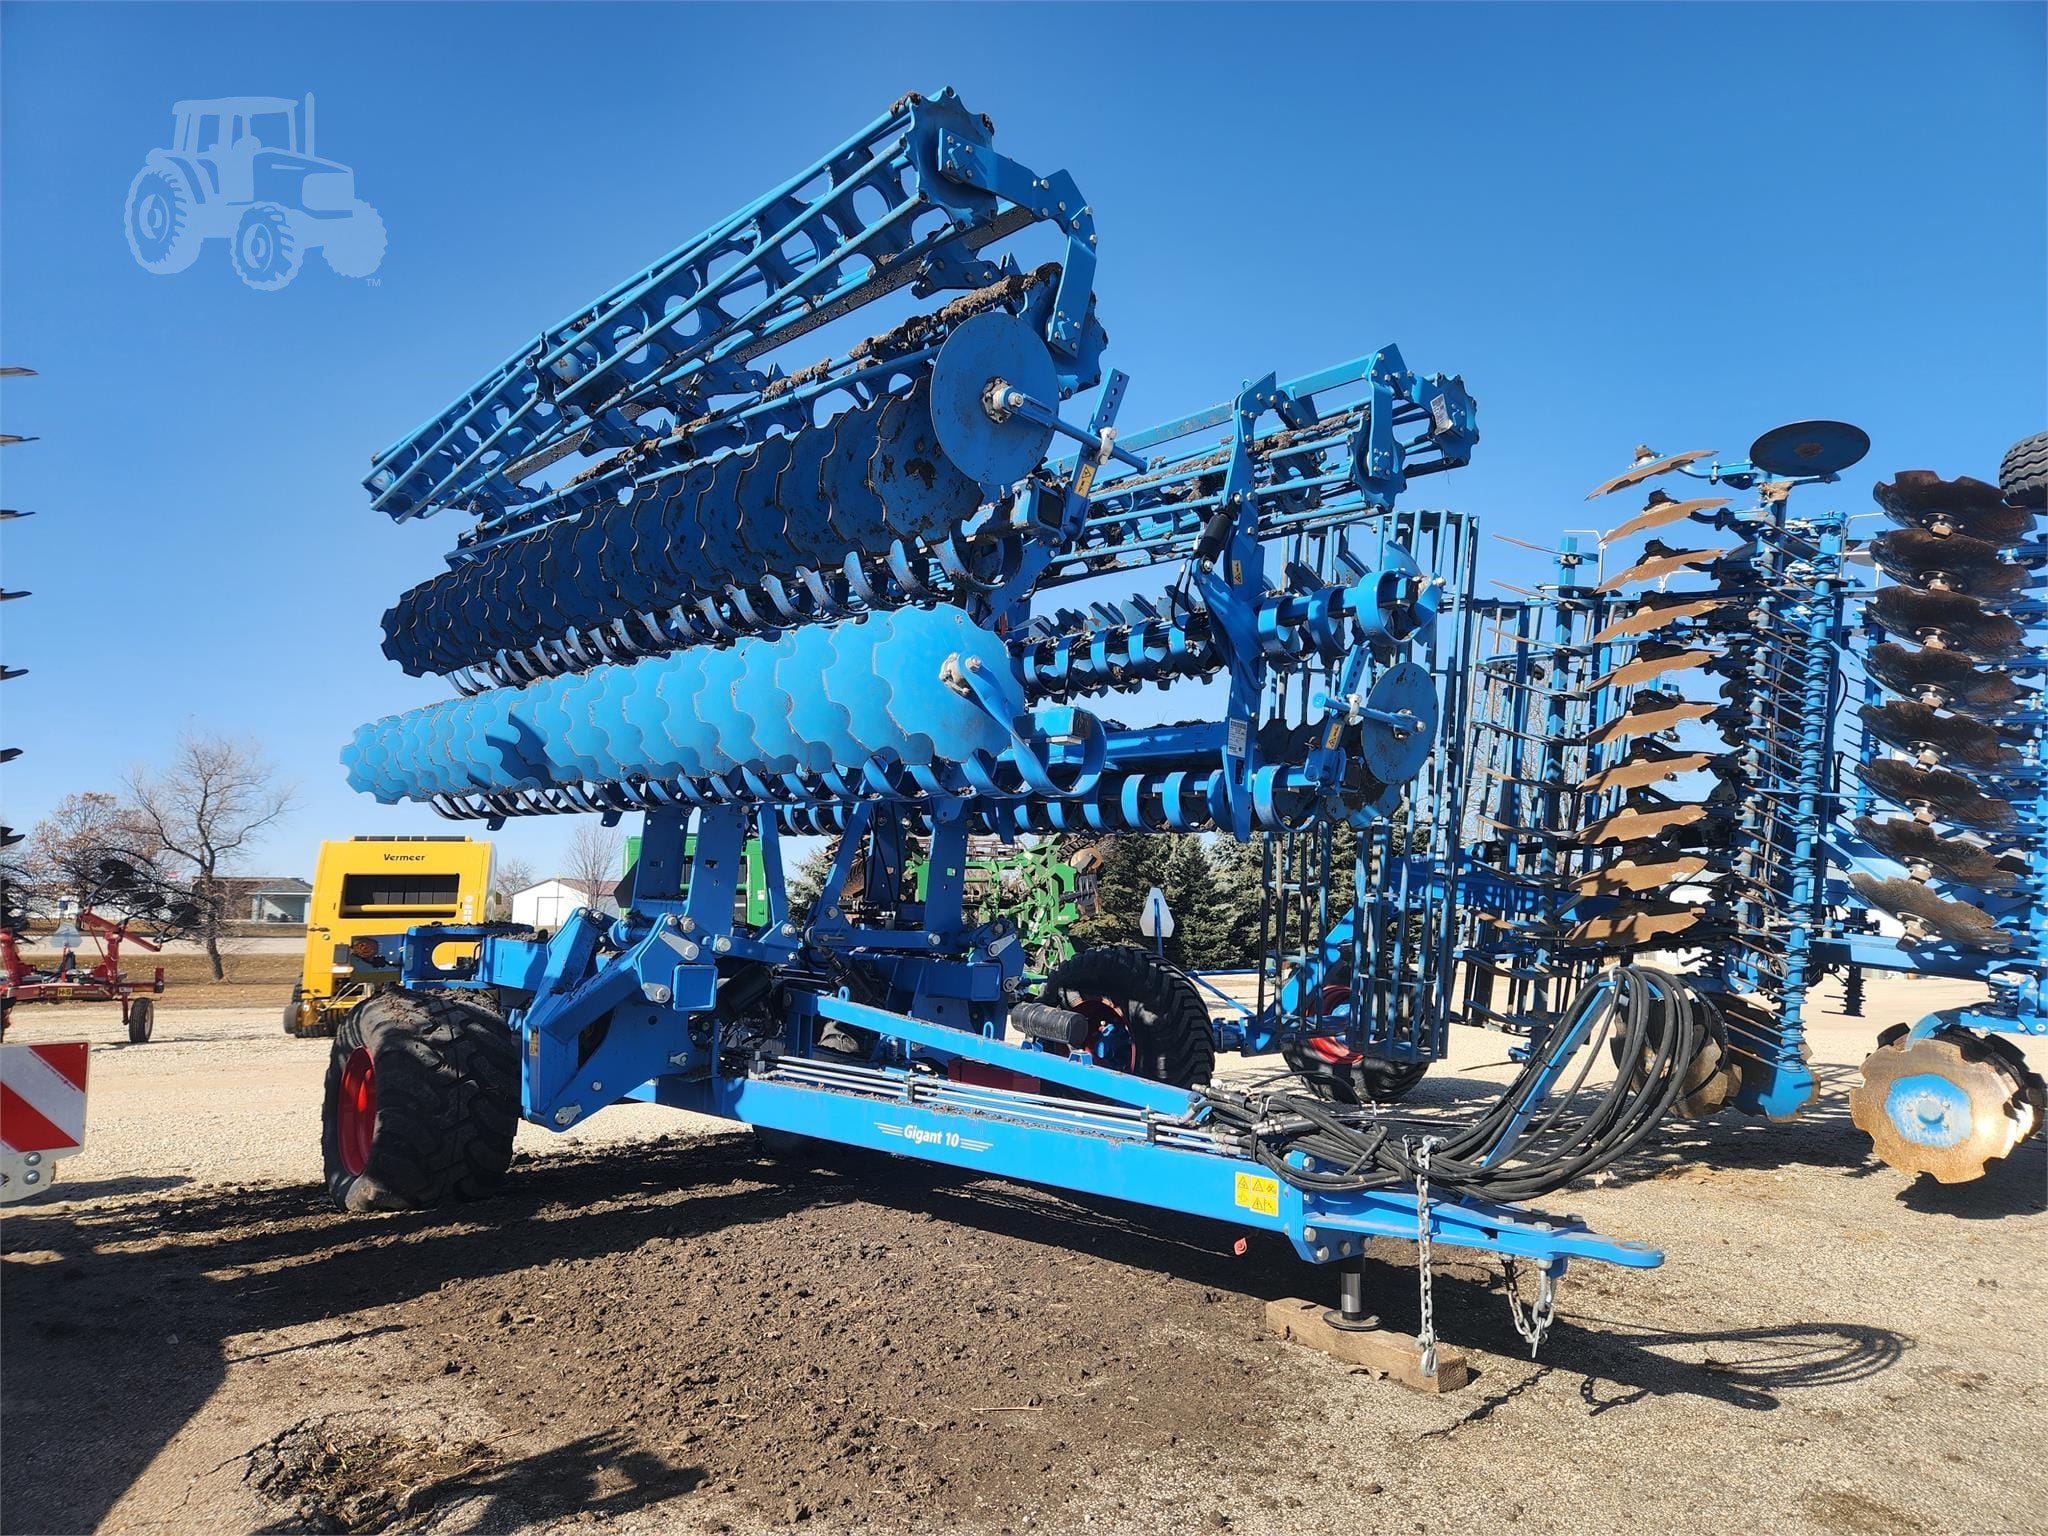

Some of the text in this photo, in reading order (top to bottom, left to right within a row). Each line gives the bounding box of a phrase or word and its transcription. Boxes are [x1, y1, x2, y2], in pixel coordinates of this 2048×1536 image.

[383, 853, 426, 861] Vermeer
[903, 1124, 960, 1148] Gigant 10
